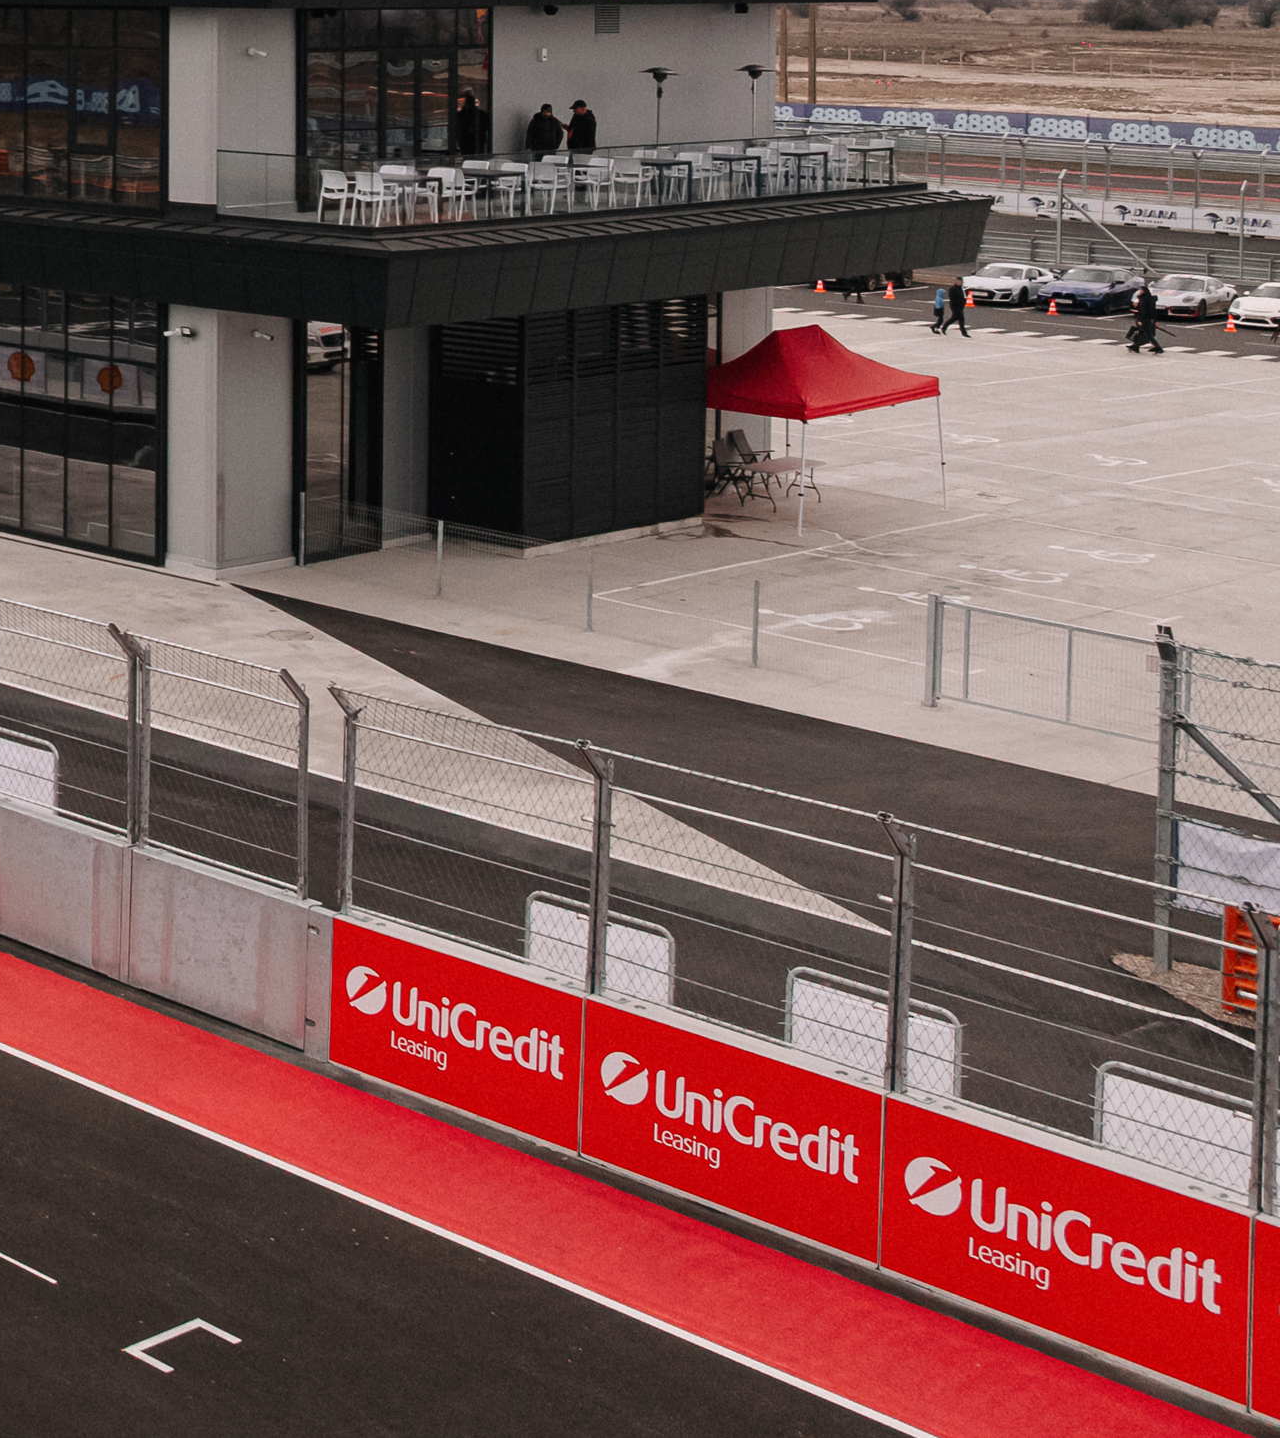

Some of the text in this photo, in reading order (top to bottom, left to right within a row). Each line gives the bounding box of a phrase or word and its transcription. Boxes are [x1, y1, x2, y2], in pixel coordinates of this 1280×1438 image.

[390, 1029, 448, 1072] Leasing
[391, 980, 565, 1081] UniCredit
[652, 1122, 722, 1169] Leasing
[655, 1069, 861, 1184] UniCredit
[967, 1236, 1051, 1291] Leasing
[970, 1177, 1223, 1316] UniCredit
